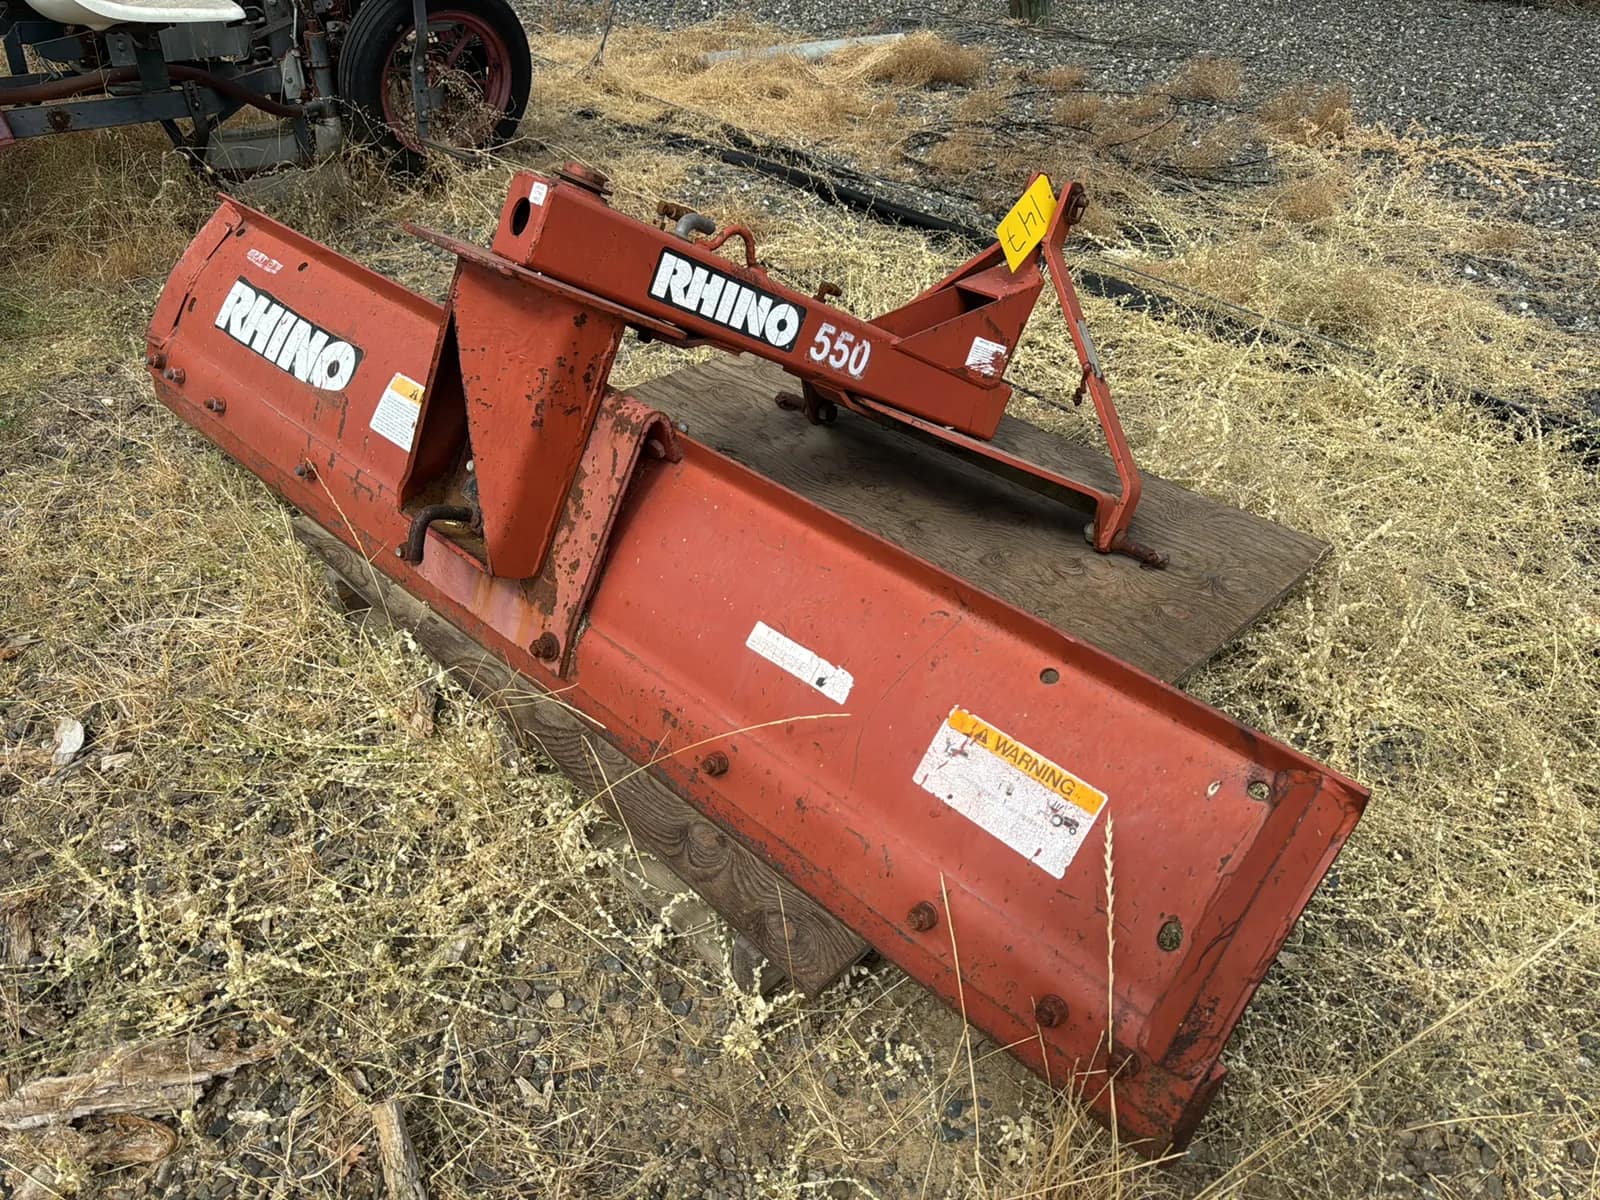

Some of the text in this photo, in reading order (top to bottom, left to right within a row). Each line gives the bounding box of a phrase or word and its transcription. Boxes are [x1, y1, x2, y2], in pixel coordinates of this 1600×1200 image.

[1007, 194, 1046, 252] 147
[215, 280, 356, 392] RHINO
[650, 251, 871, 377] RHINO 550
[994, 735, 1077, 797] WARNING
